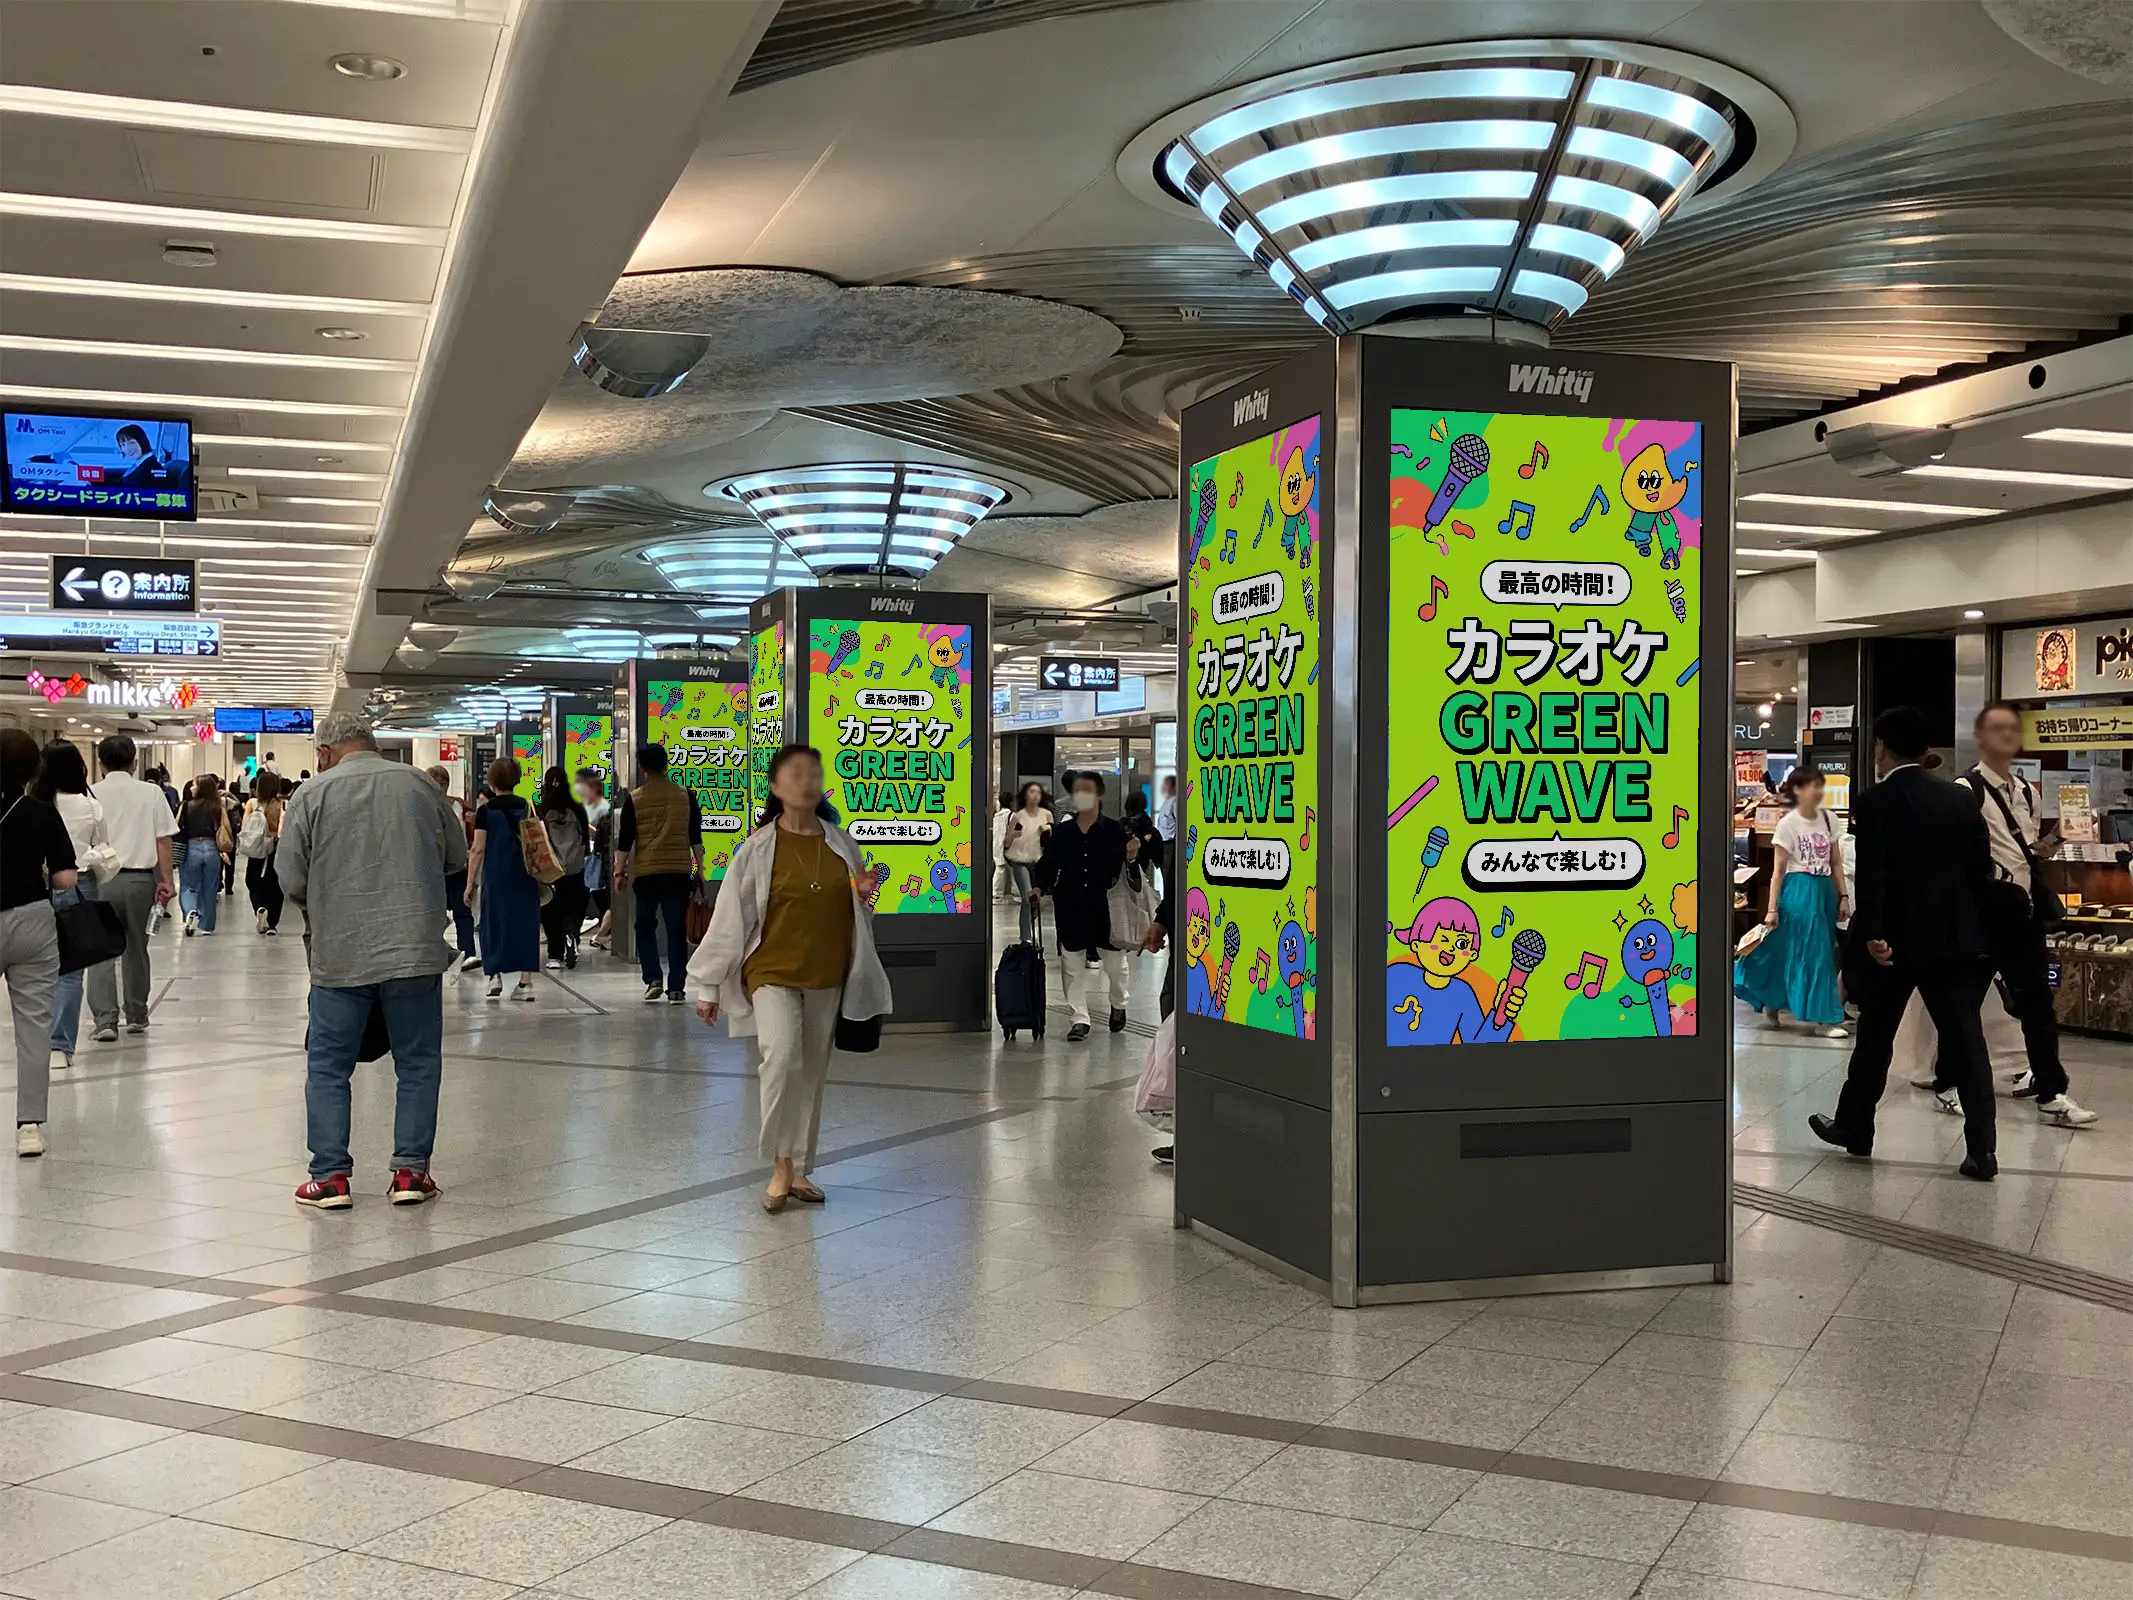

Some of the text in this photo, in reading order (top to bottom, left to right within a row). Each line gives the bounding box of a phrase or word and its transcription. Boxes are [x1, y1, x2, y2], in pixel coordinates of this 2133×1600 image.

[1508, 363, 1595, 403] Whity
[1233, 388, 1270, 427] Whity
[133, 572, 191, 591] 案内所
[133, 590, 190, 601] Information
[1196, 623, 1304, 700] カラオケ
[1445, 617, 1668, 687] カラオケ
[1083, 666, 1117, 679] 案内所
[838, 715, 953, 748] カラオケ
[1194, 692, 1304, 762] GREEN
[1439, 690, 1669, 755] GREEN
[2035, 716, 2133, 733] お持ち帰りコーナー
[668, 745, 747, 767] カラオケ
[834, 749, 954, 782] GREEN
[695, 790, 744, 811] AVE
[843, 782, 946, 814] WAVE
[1199, 762, 1295, 823] WAVE
[1455, 760, 1652, 824] WAVE
